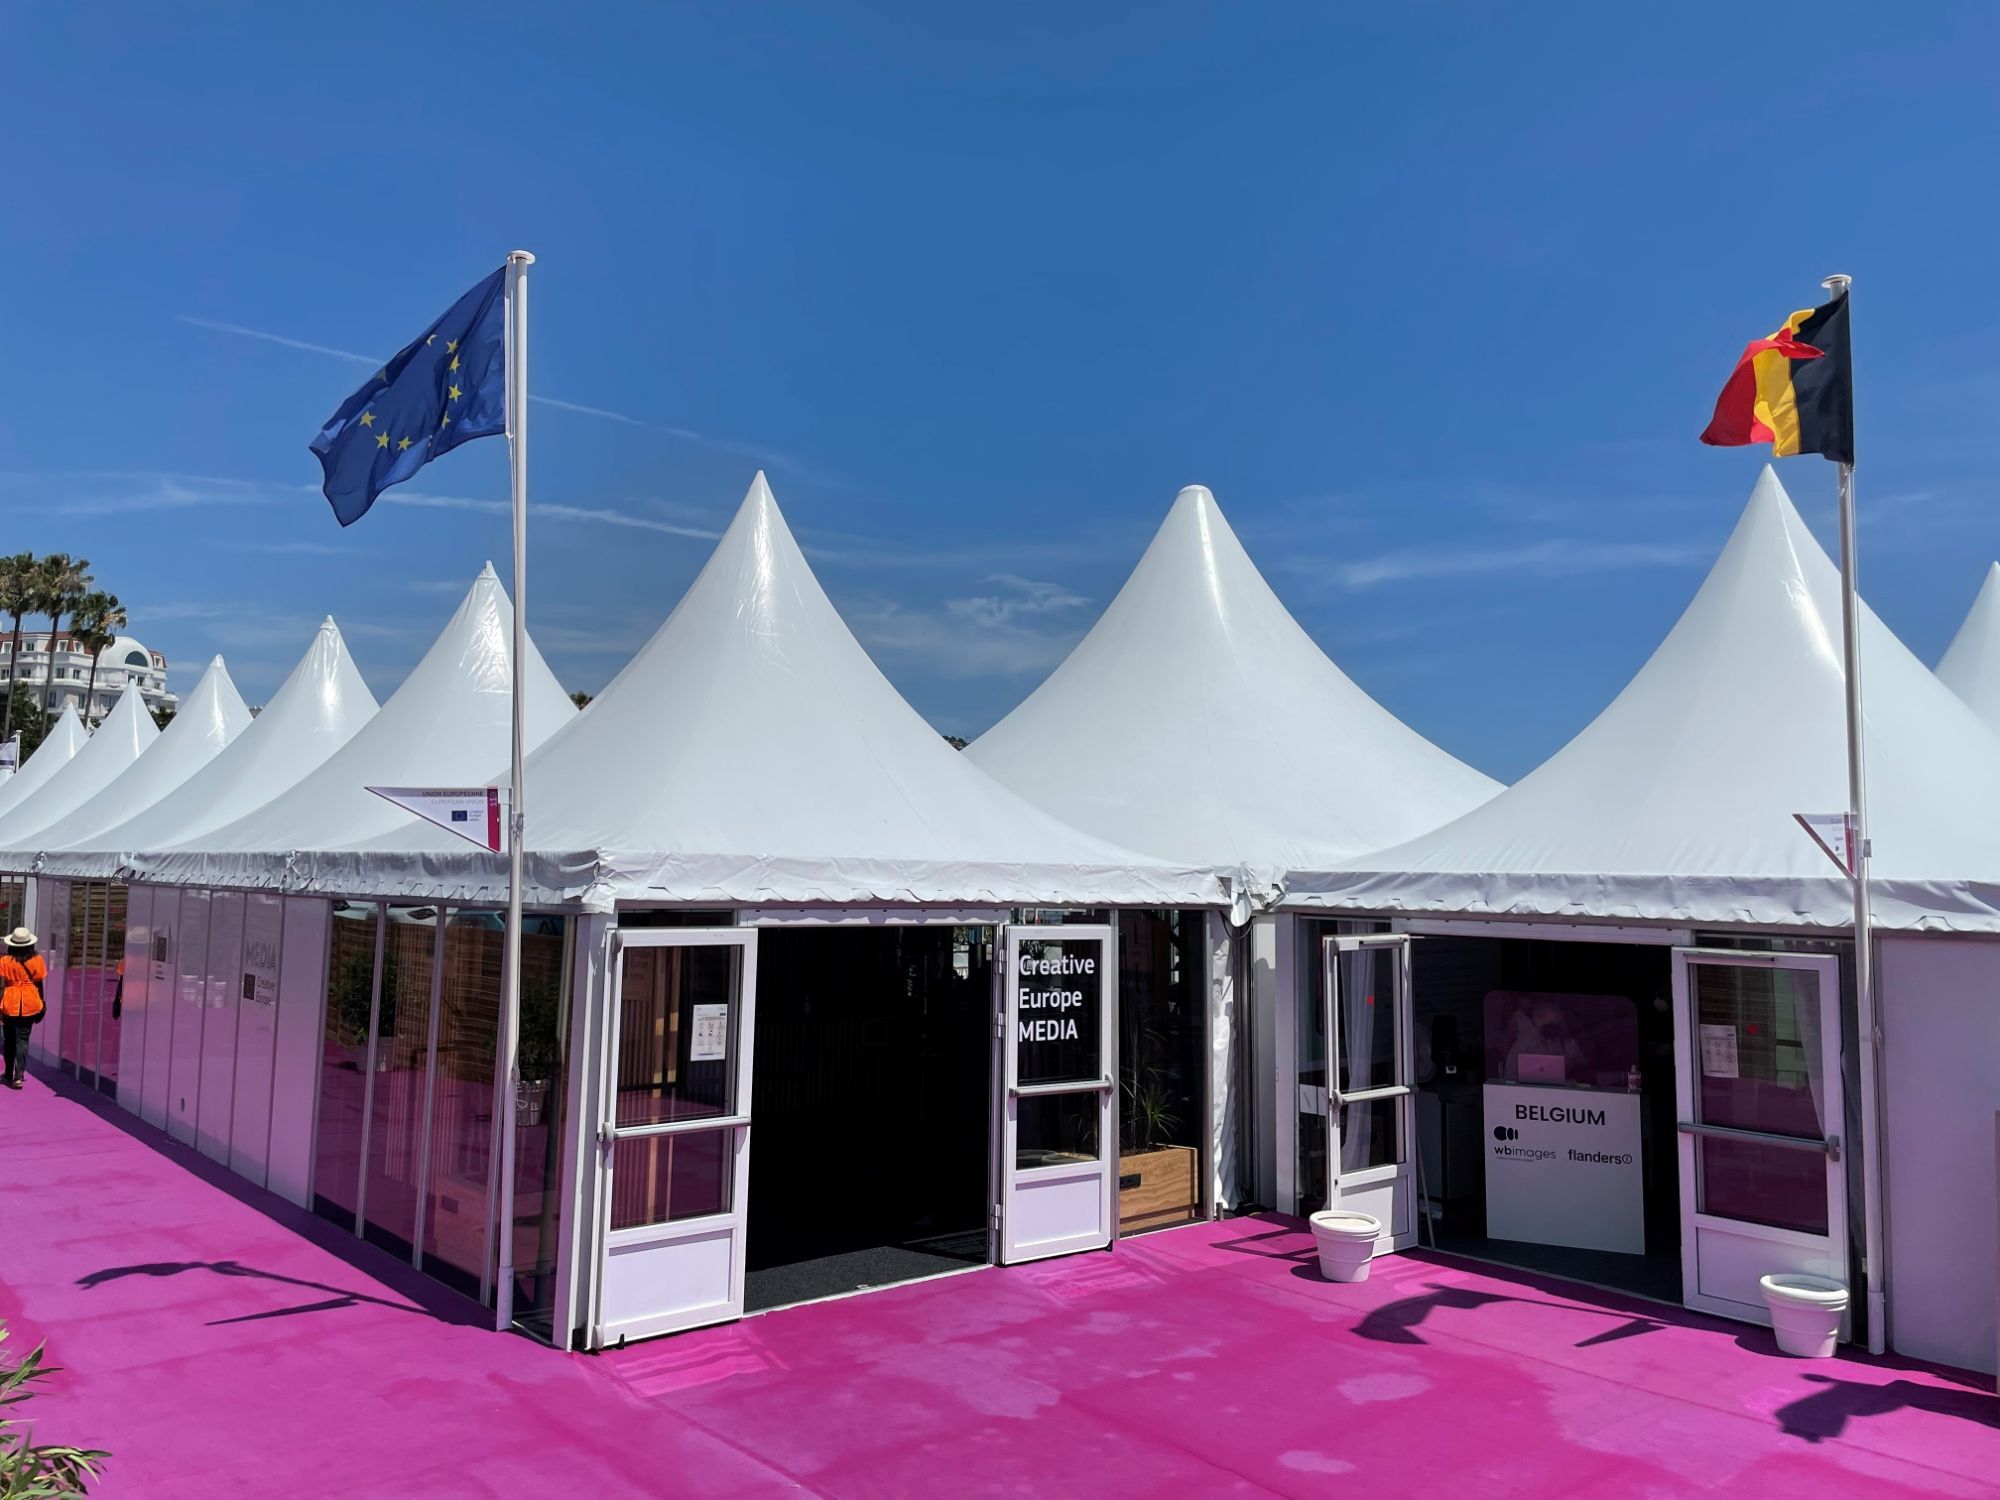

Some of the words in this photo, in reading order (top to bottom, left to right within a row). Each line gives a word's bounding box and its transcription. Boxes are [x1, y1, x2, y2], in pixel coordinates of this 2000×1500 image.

[1020, 954, 1095, 976] Creative
[255, 991, 272, 1007] Europe
[1019, 988, 1083, 1013] Europe
[1019, 1019, 1078, 1042] MEDIA
[1515, 1104, 1606, 1126] BELGIUM
[1494, 1145, 1557, 1161] wbimages
